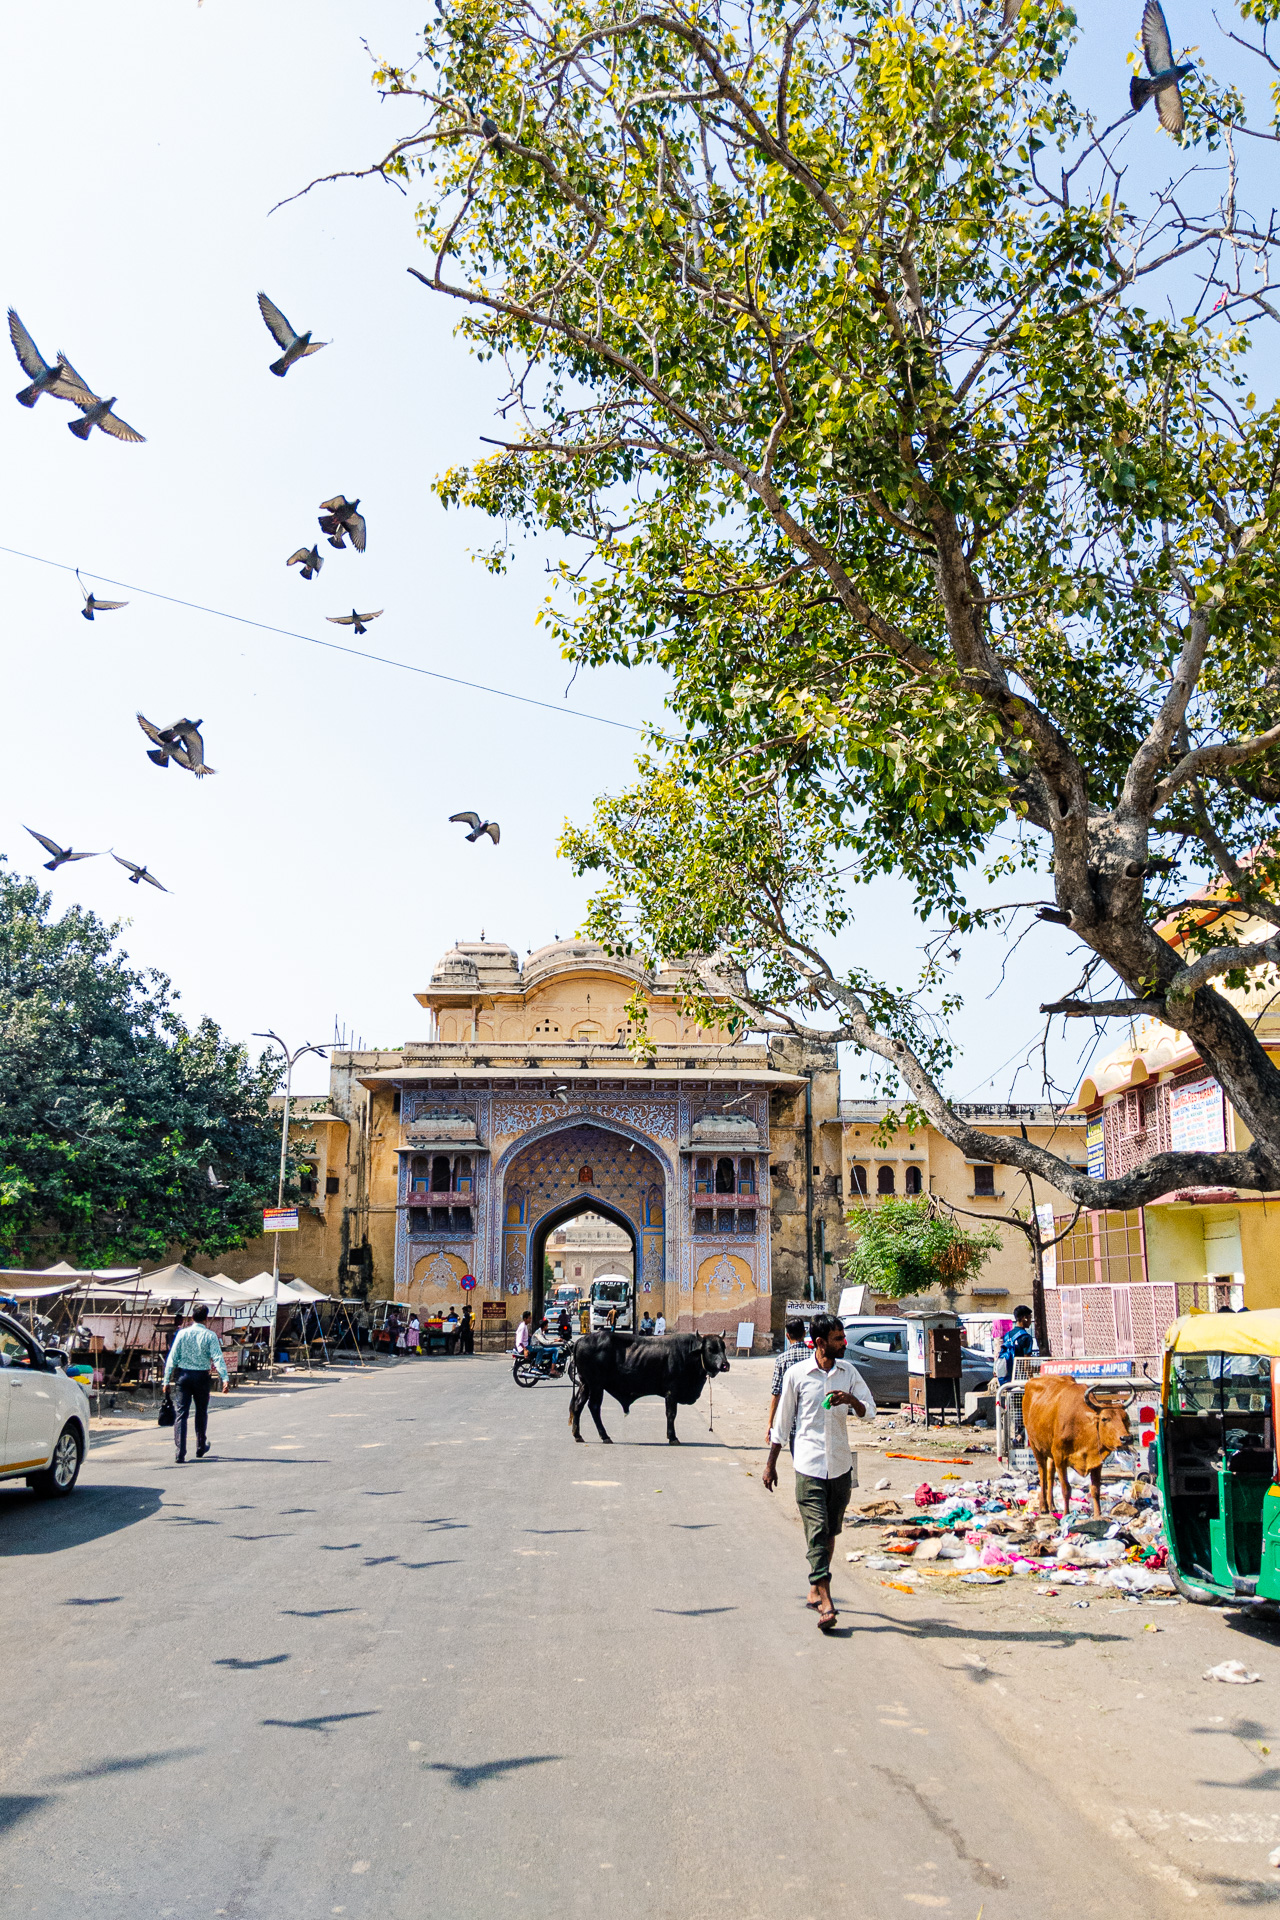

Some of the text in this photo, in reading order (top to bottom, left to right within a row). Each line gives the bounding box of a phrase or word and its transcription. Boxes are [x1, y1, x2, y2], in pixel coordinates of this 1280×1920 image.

[1044, 1363, 1128, 1374] TRAFFIC POLICE JAIPUR
